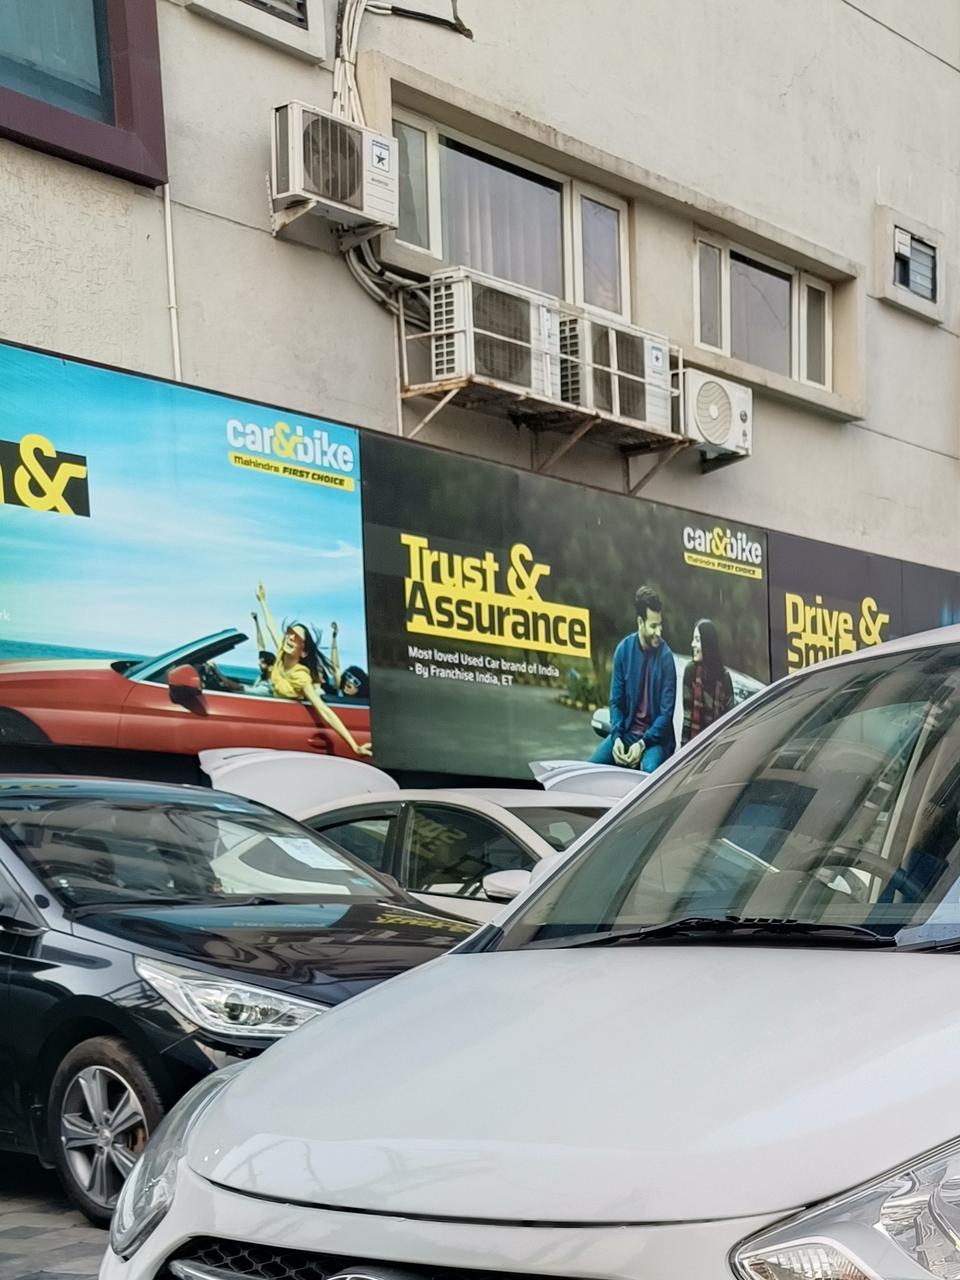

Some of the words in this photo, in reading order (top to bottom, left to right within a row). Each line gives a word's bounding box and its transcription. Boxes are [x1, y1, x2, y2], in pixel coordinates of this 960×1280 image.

[226, 419, 354, 472] car&bike
[234, 455, 280, 473] Mahindra
[282, 466, 311, 479] FIRST
[311, 472, 345, 486] CHOICE
[683, 526, 762, 564] car&bike
[400, 533, 499, 594] Trust
[507, 543, 550, 602] &
[406, 581, 587, 650] Assurance
[785, 592, 854, 641] Drive
[859, 597, 890, 645] &
[408, 645, 433, 660] Most
[434, 649, 459, 664] loved
[460, 653, 483, 667] Used
[485, 657, 500, 670] Car
[501, 659, 526, 673] brand
[527, 663, 537, 674] of
[538, 665, 560, 677] India
[787, 632, 855, 669] Smil
[415, 662, 429, 678] By
[430, 664, 474, 682] Franchise
[476, 672, 500, 686] India,
[501, 674, 514, 686] ET
